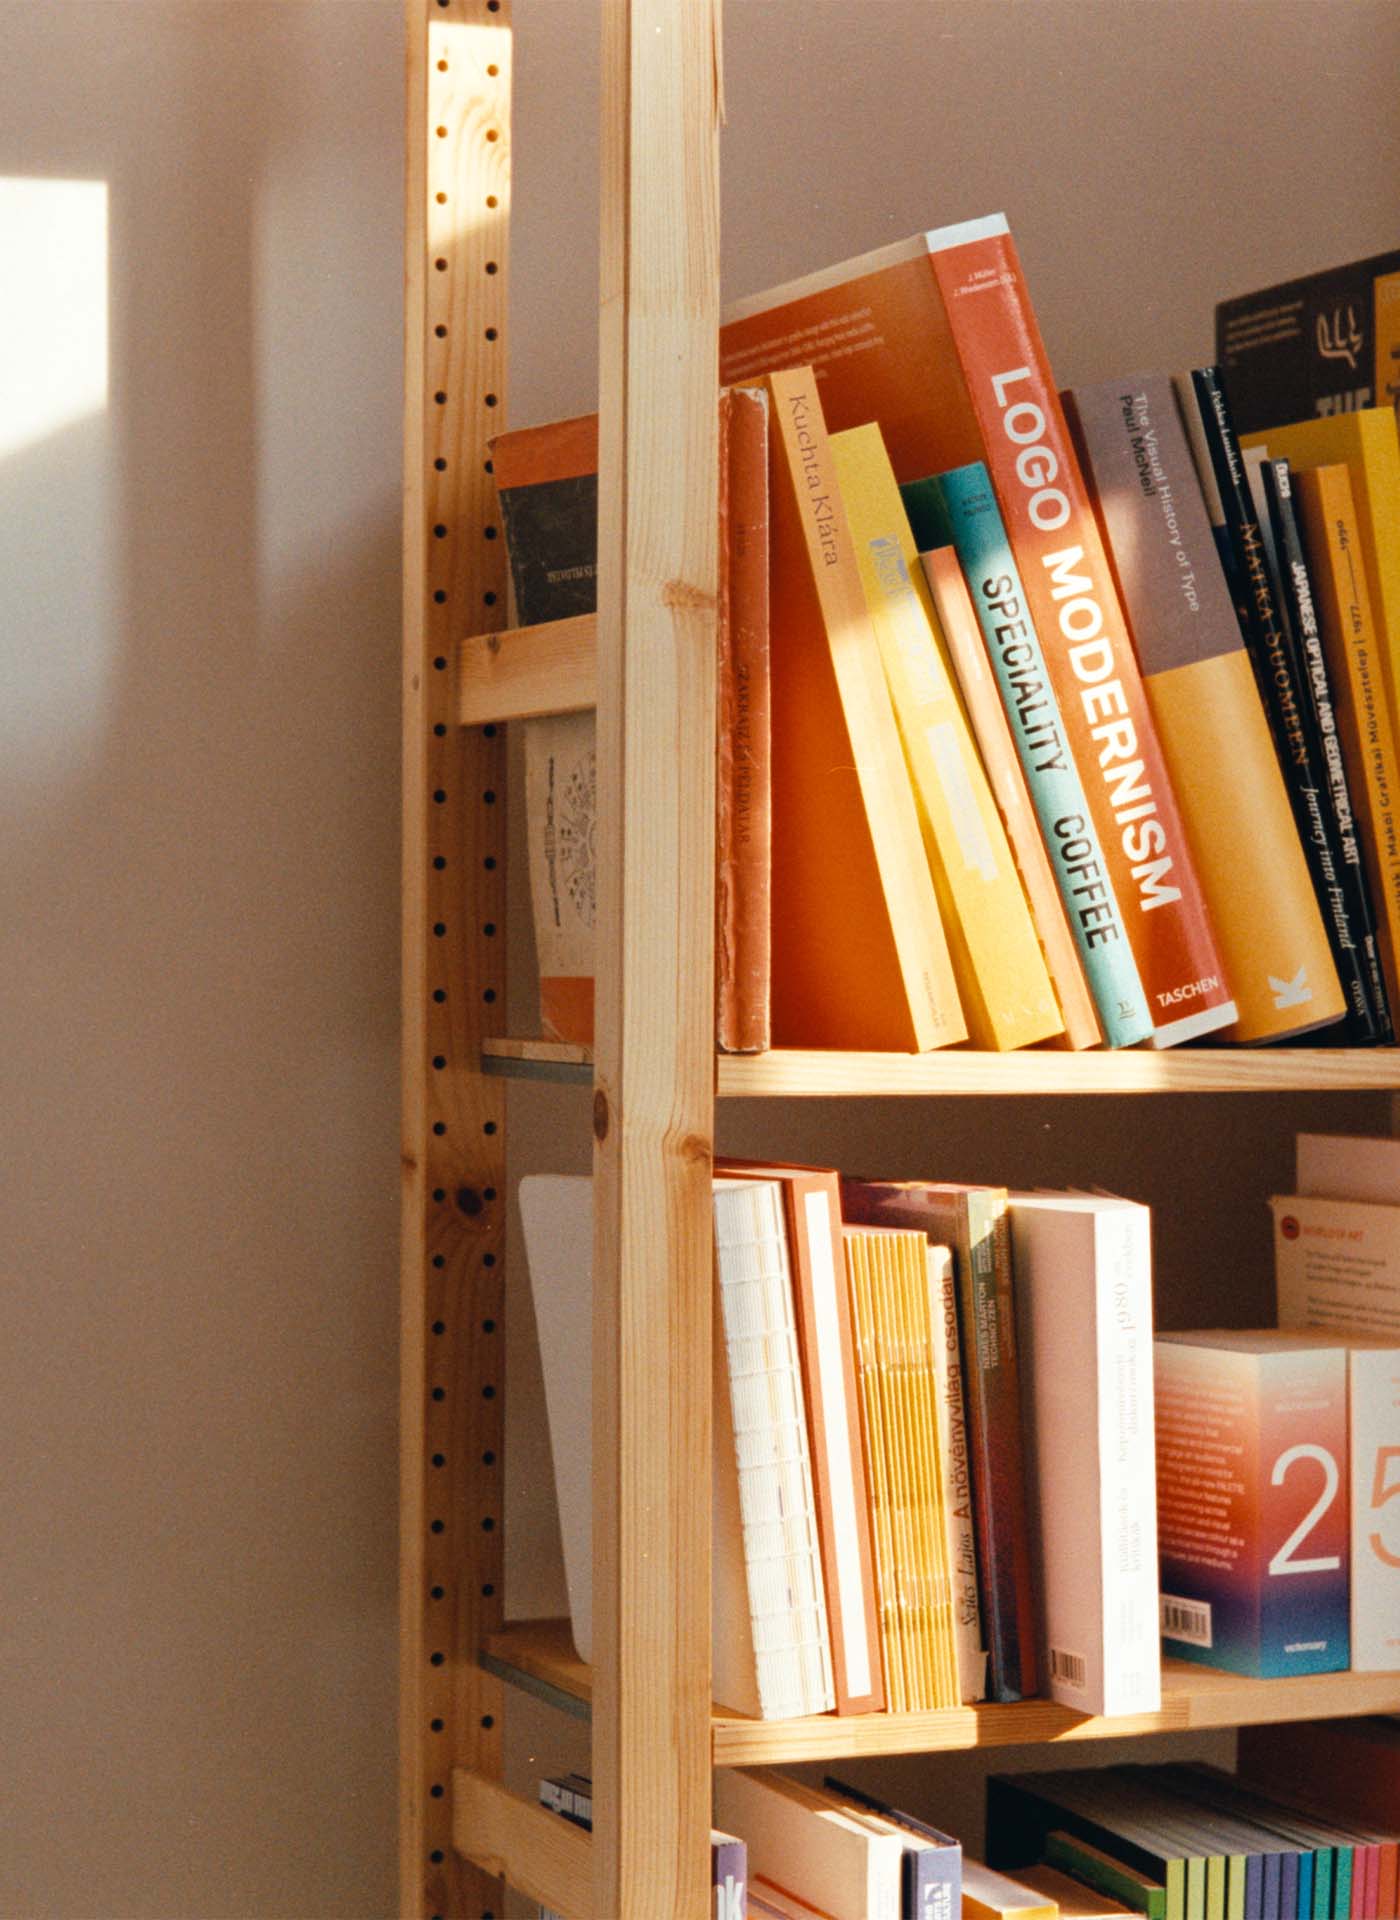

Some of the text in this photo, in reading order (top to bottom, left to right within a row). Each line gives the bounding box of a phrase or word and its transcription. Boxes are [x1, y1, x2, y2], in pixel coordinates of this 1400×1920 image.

[789, 394, 838, 567] Kuchta Klára
[1119, 395, 1158, 498] Paul McNeil
[1134, 391, 1200, 613] The Visual History of Type
[991, 366, 1183, 912] LOGO MODERNISM
[983, 574, 1119, 949] SPECIALITY COFFEE
[1291, 560, 1361, 866] JAPANESE OPTICAL AND GEOMETRICAL ART
[1370, 747, 1390, 808] Grafikai
[1301, 785, 1357, 950] Journey into Finland
[1157, 976, 1220, 1008] TASCHEN
[944, 1363, 971, 1497] növényvilág
[953, 1502, 970, 1519] A
[957, 1533, 978, 1577] Lajos
[1268, 1443, 1341, 1576] 2
